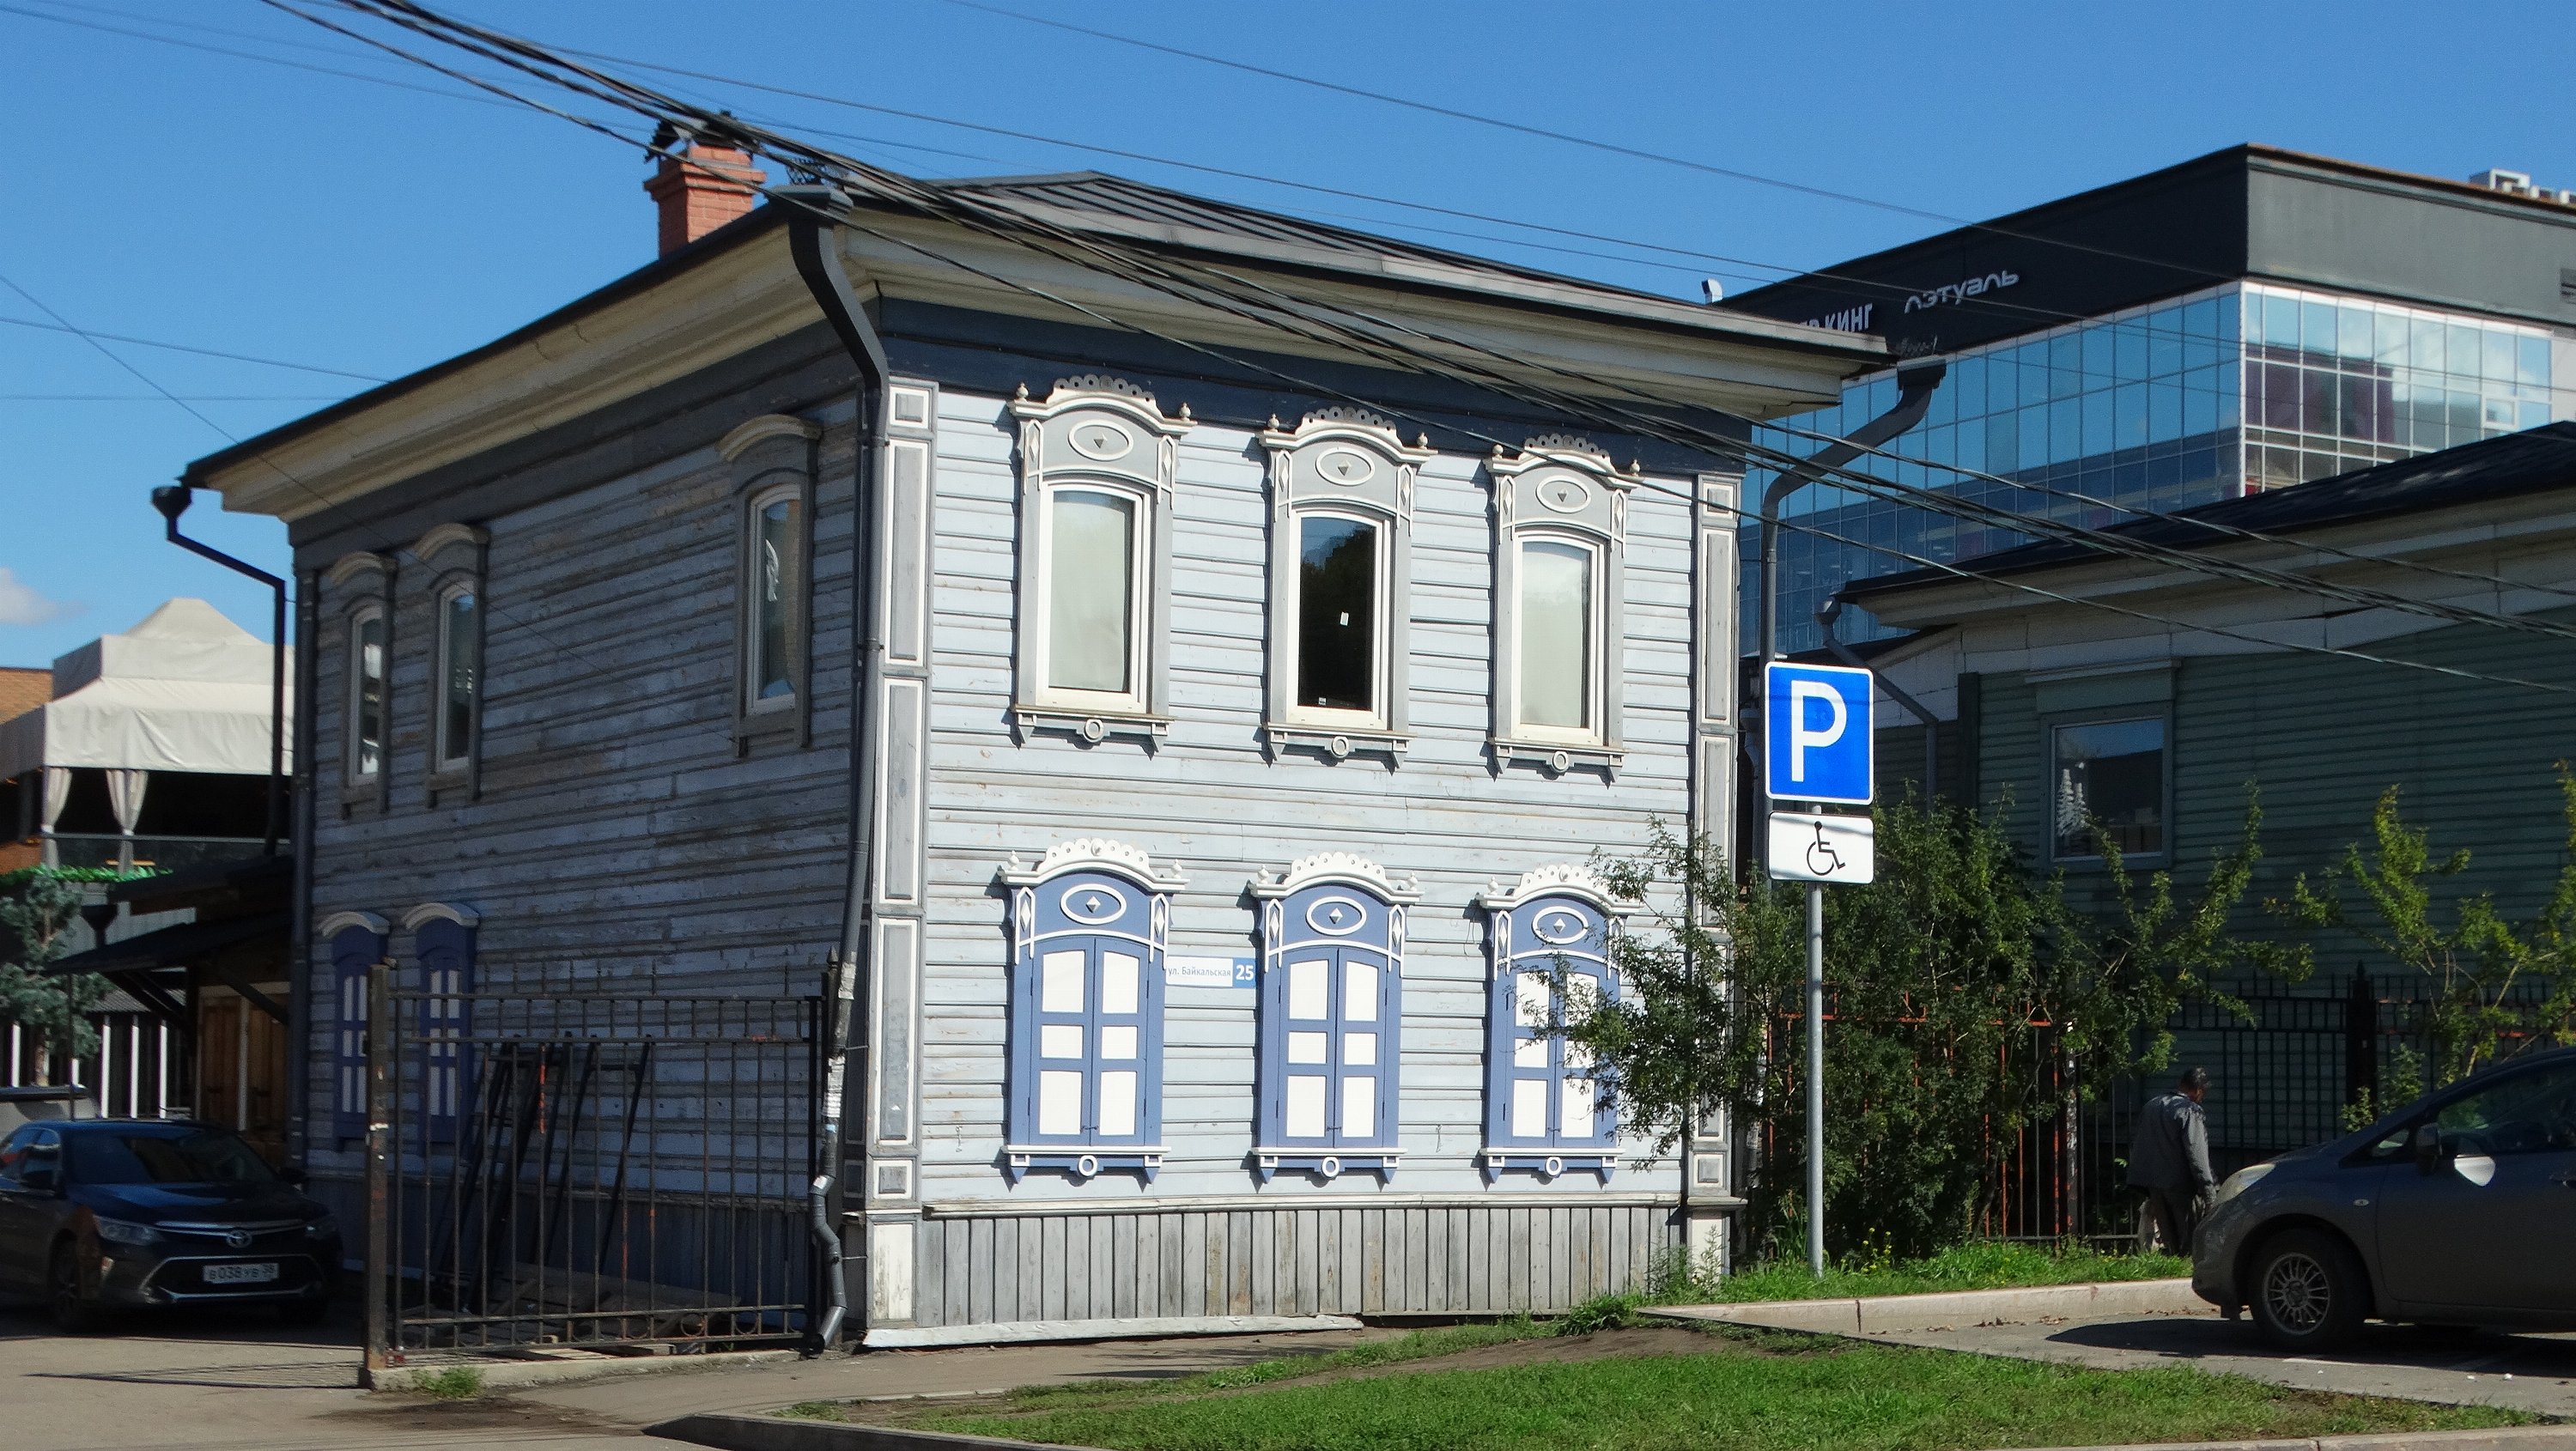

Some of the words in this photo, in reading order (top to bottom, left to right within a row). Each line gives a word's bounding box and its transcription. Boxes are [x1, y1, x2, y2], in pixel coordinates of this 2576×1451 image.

[1791, 679, 1847, 782] P
[1168, 967, 1179, 976] ул.
[1182, 966, 1231, 977] Байкальская
[1236, 964, 1254, 981] 25
